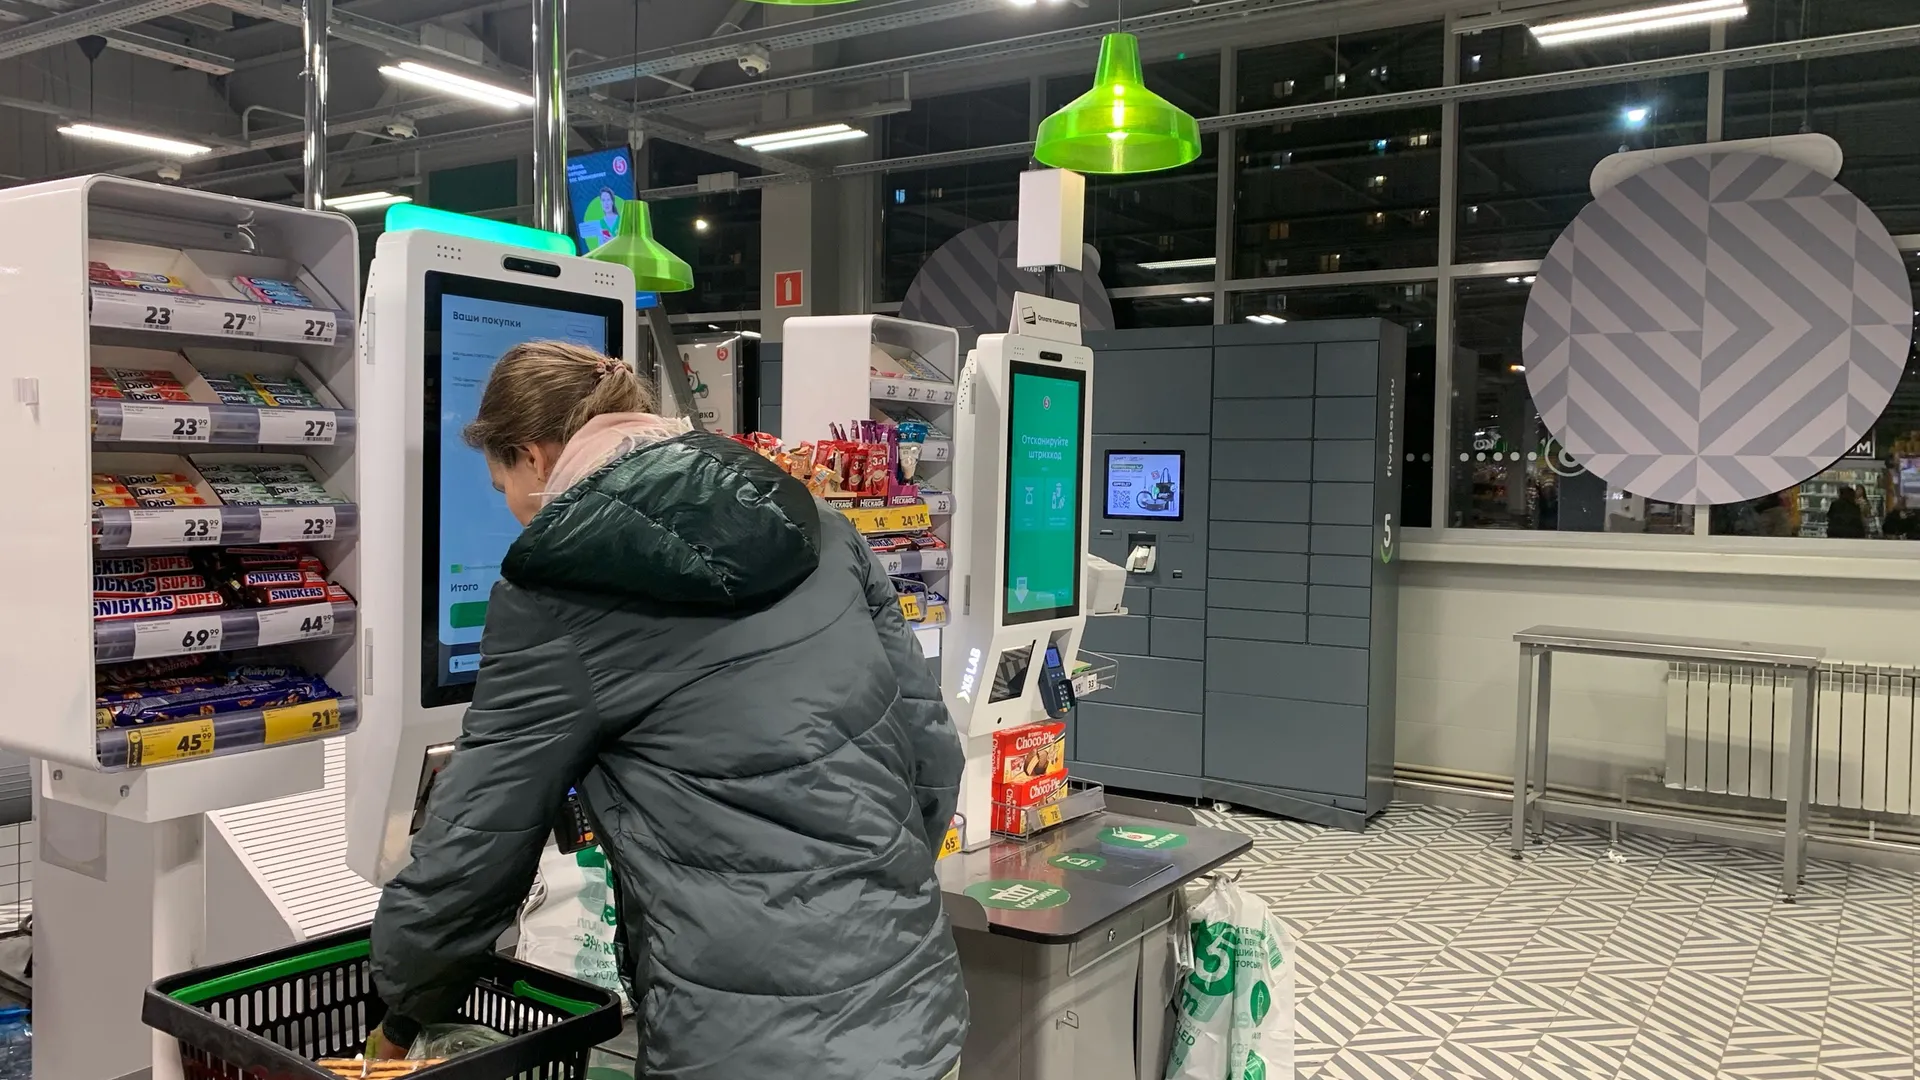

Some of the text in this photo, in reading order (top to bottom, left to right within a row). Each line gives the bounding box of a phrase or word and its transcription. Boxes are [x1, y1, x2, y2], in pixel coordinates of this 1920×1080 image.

[144, 306, 171, 325] 23
[223, 312, 247, 330] 27
[453, 311, 522, 329] Ваши покупки
[304, 319, 326, 337] 27
[115, 368, 144, 378] Dirol
[125, 381, 154, 390] Dirol
[887, 385, 896, 395] 23
[908, 387, 917, 397] 27
[133, 392, 162, 401] Dirol
[926, 389, 935, 399] 27
[172, 418, 208, 435] 23 99
[304, 420, 326, 436] 27
[1021, 434, 1069, 448] Отсканируйте
[1028, 450, 1062, 461] штрихкод
[260, 465, 281, 473] Dirol
[128, 475, 158, 484] Dirol
[138, 486, 167, 496] Dirol
[276, 486, 299, 494] Dirol
[146, 499, 176, 508] Dirol
[184, 519, 219, 537] 23 99
[303, 518, 334, 535] 23 99
[150, 556, 193, 571] SUPER
[162, 575, 204, 590] SUPER
[248, 572, 300, 584] SNICKERS
[271, 587, 323, 600] SNICKERS
[450, 582, 479, 593] Итого
[180, 593, 222, 607] SUPER
[300, 615, 323, 632] 44
[182, 628, 219, 647] 69 99
[965, 647, 981, 675] LAB
[312, 709, 330, 728] 21
[177, 732, 212, 752] 45 99
[944, 837, 956, 851] 65
[1014, 888, 1061, 908] КОРЗИНА
[1195, 926, 1236, 983] 5
